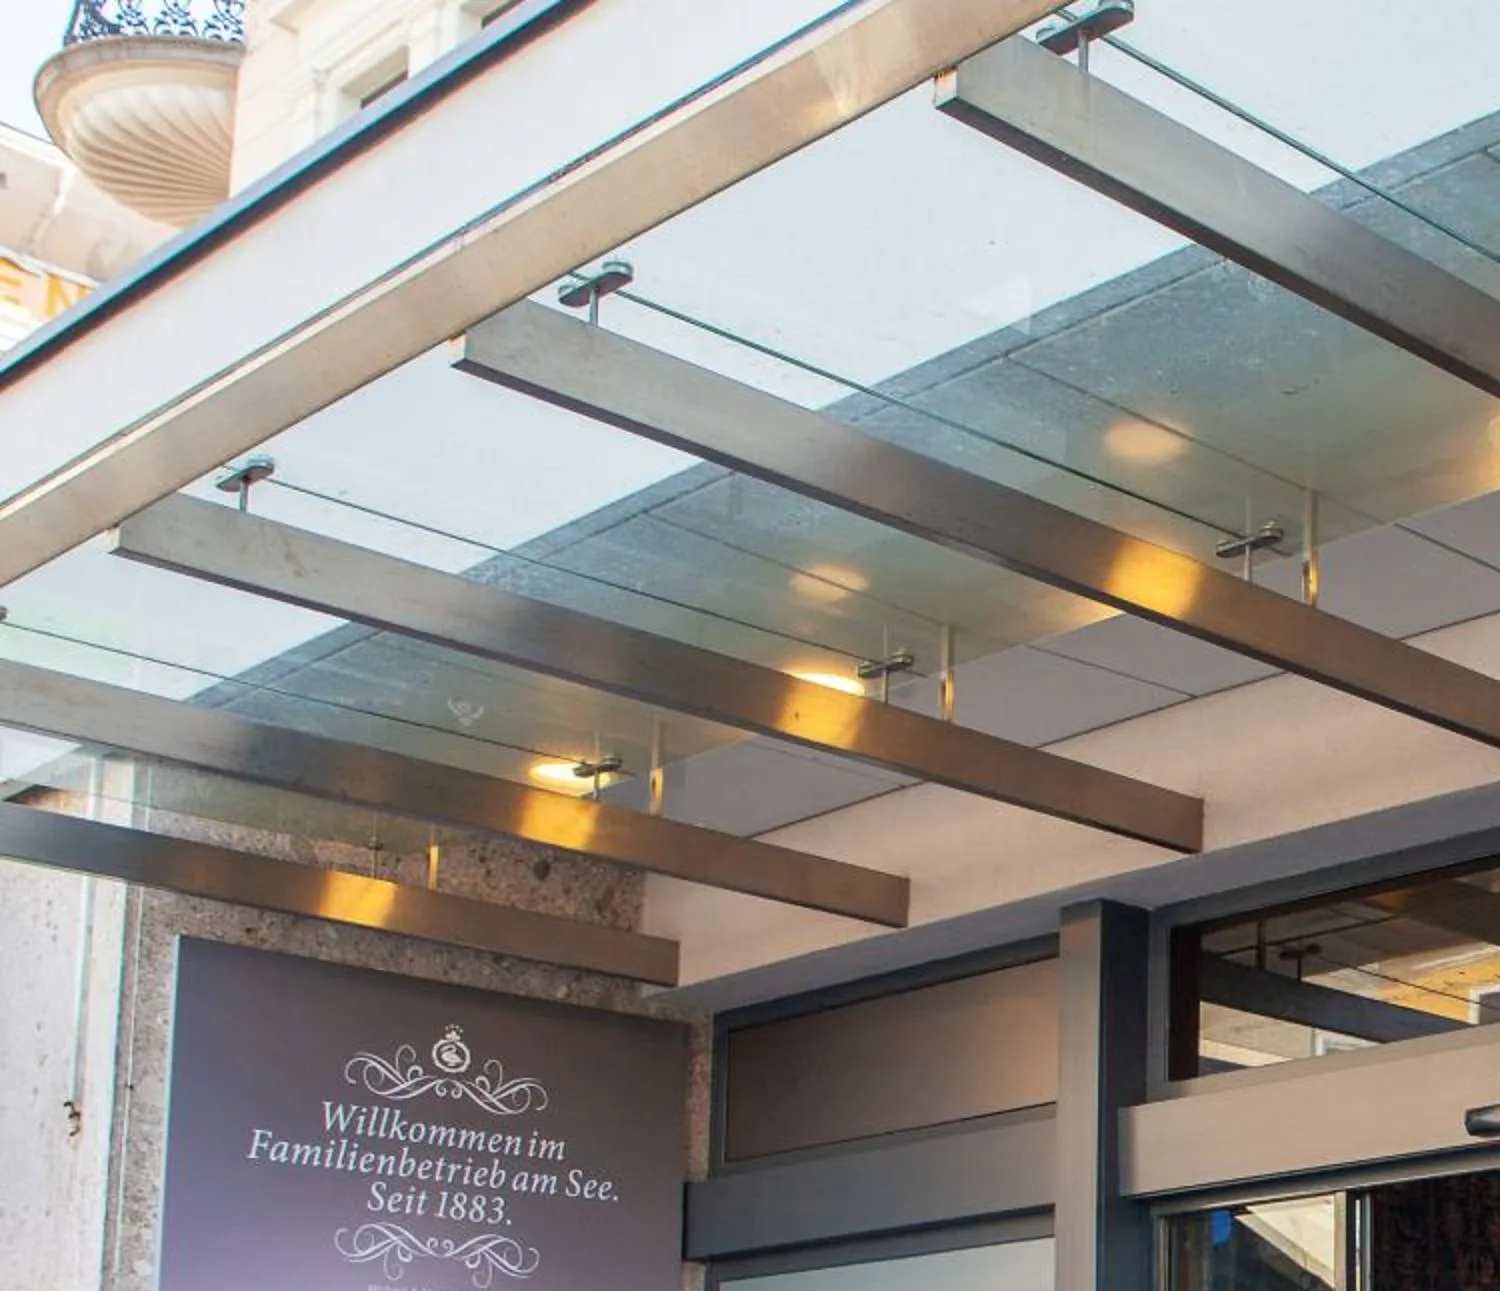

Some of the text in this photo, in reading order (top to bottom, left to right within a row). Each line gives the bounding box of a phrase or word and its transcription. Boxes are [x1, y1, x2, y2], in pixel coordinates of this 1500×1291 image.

[321, 1100, 567, 1161] Willkommen im
[247, 1128, 620, 1202] Familienbetrieb am See.
[367, 1181, 513, 1226] Seit 1883.
